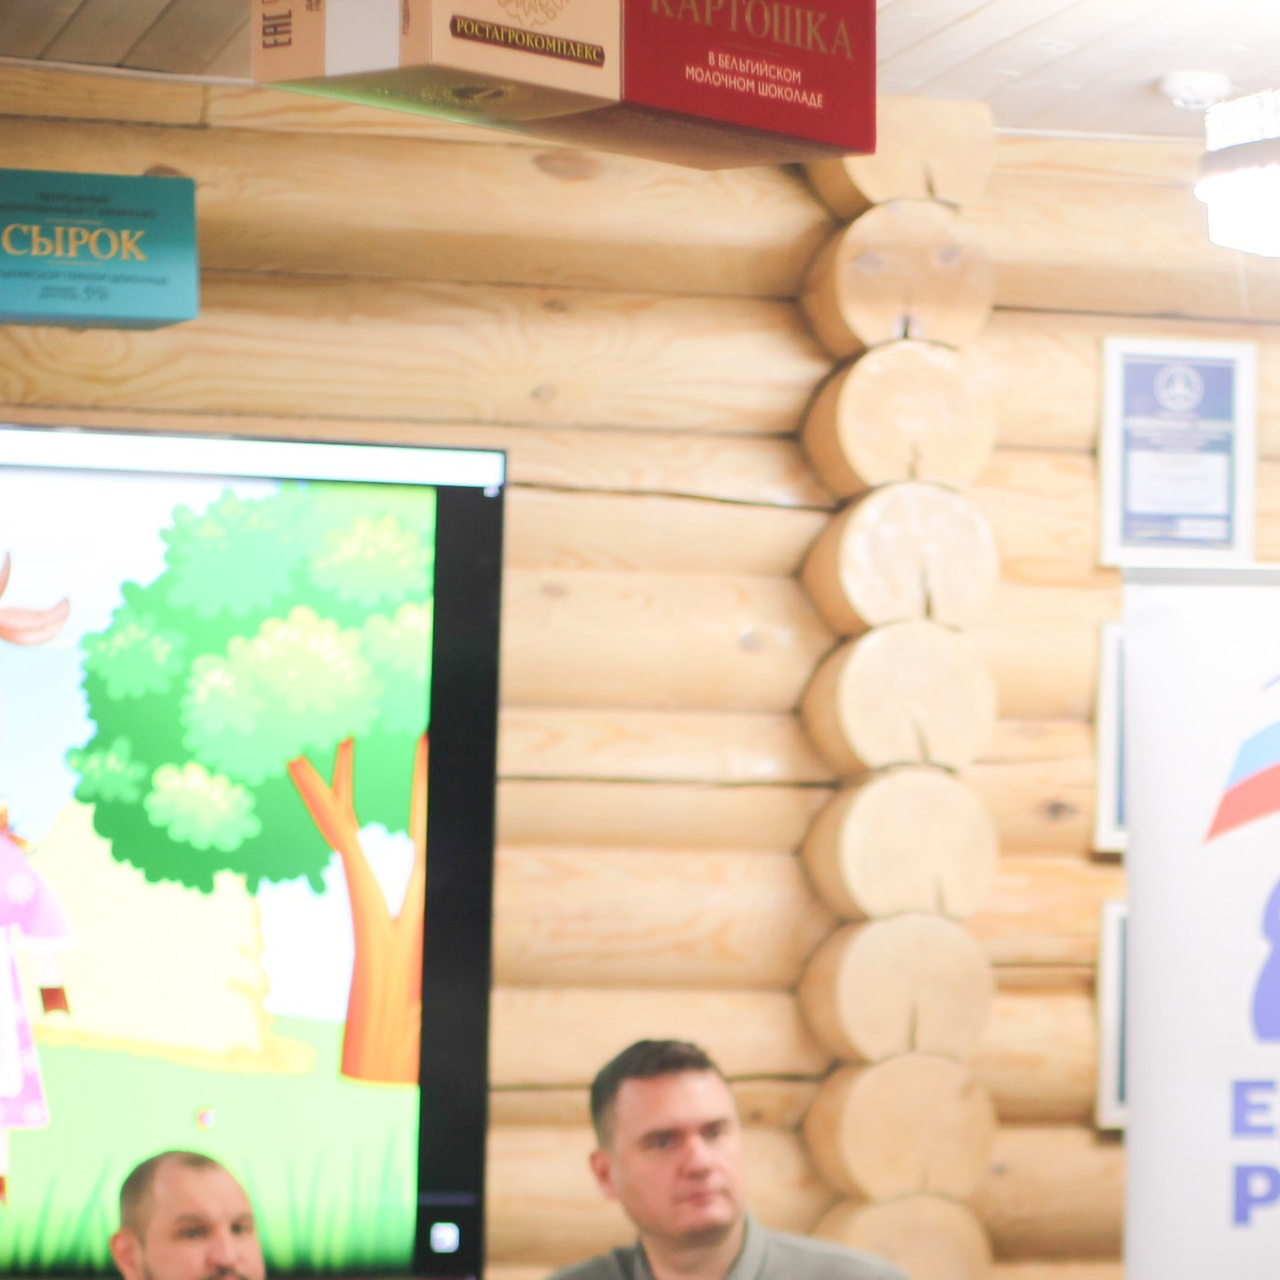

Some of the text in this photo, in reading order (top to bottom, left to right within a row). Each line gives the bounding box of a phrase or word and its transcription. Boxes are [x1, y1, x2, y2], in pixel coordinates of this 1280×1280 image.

[456, 18, 602, 62] РОСТАГРОКОМПЛЕКС
[685, 65, 824, 108] МОЛОЧНОМ ШОКОЛАДЕ
[708, 50, 801, 84] В БЕЛЬГИЙСКОМ
[1, 223, 148, 261] СЫРОК
